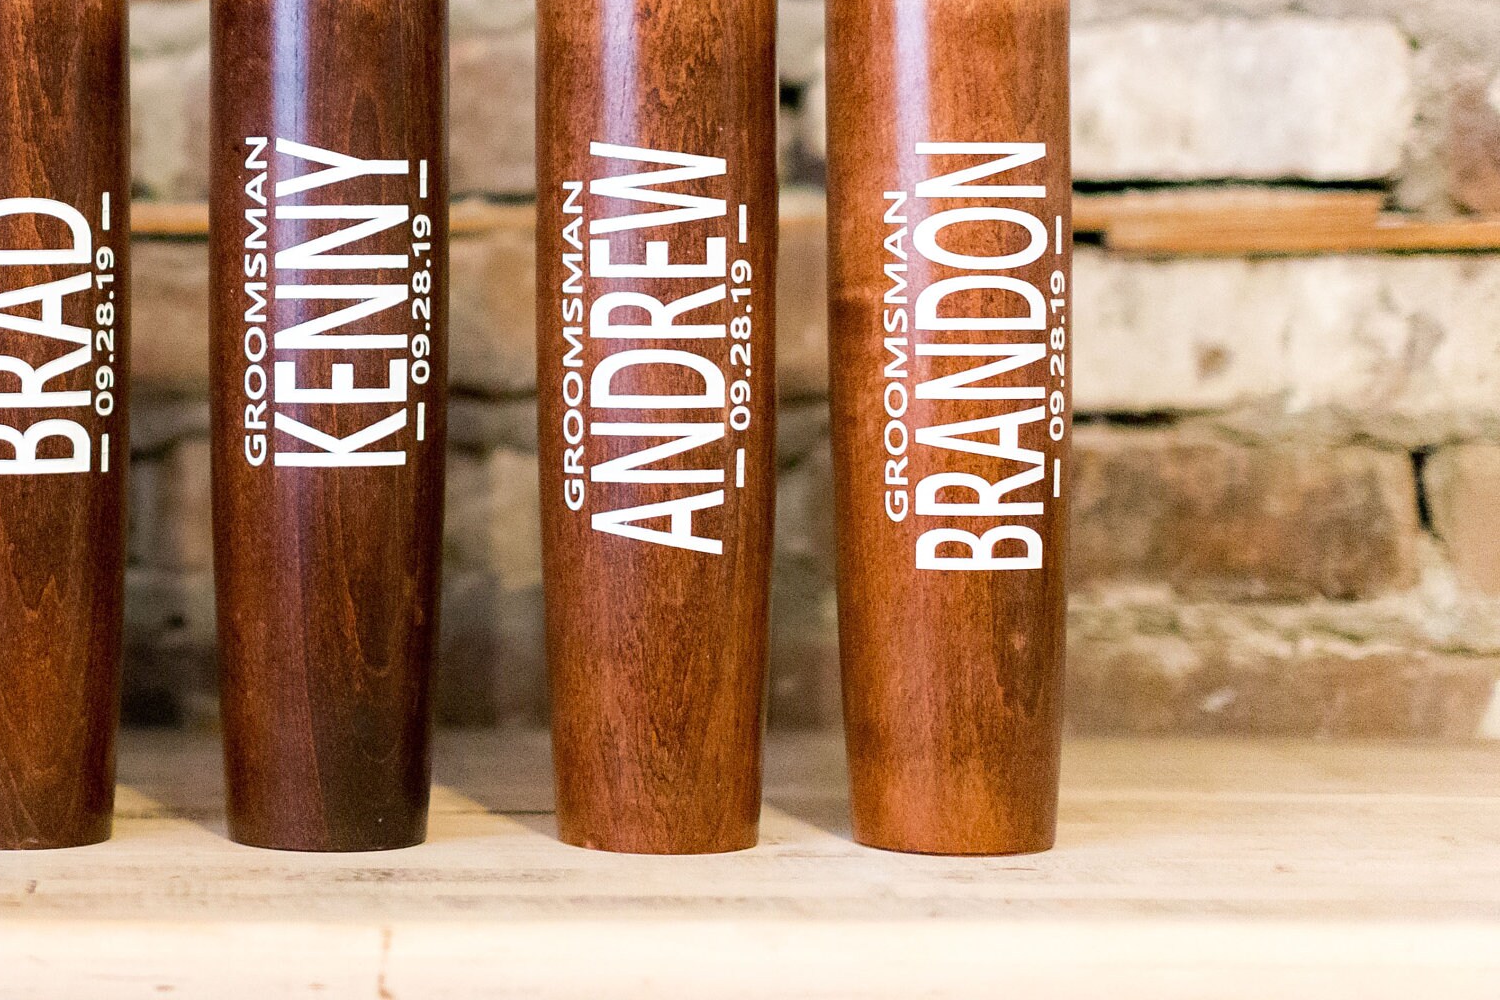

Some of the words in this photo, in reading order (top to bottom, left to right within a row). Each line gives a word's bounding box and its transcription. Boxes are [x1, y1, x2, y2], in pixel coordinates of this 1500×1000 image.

[244, 136, 269, 467] GROOMSMAN
[274, 137, 409, 467] KENNY
[561, 181, 585, 511] GROOMSMAN
[589, 141, 728, 555] ANDREW
[883, 190, 909, 523] GROOMSMAN
[912, 141, 1048, 571] BRANDON
